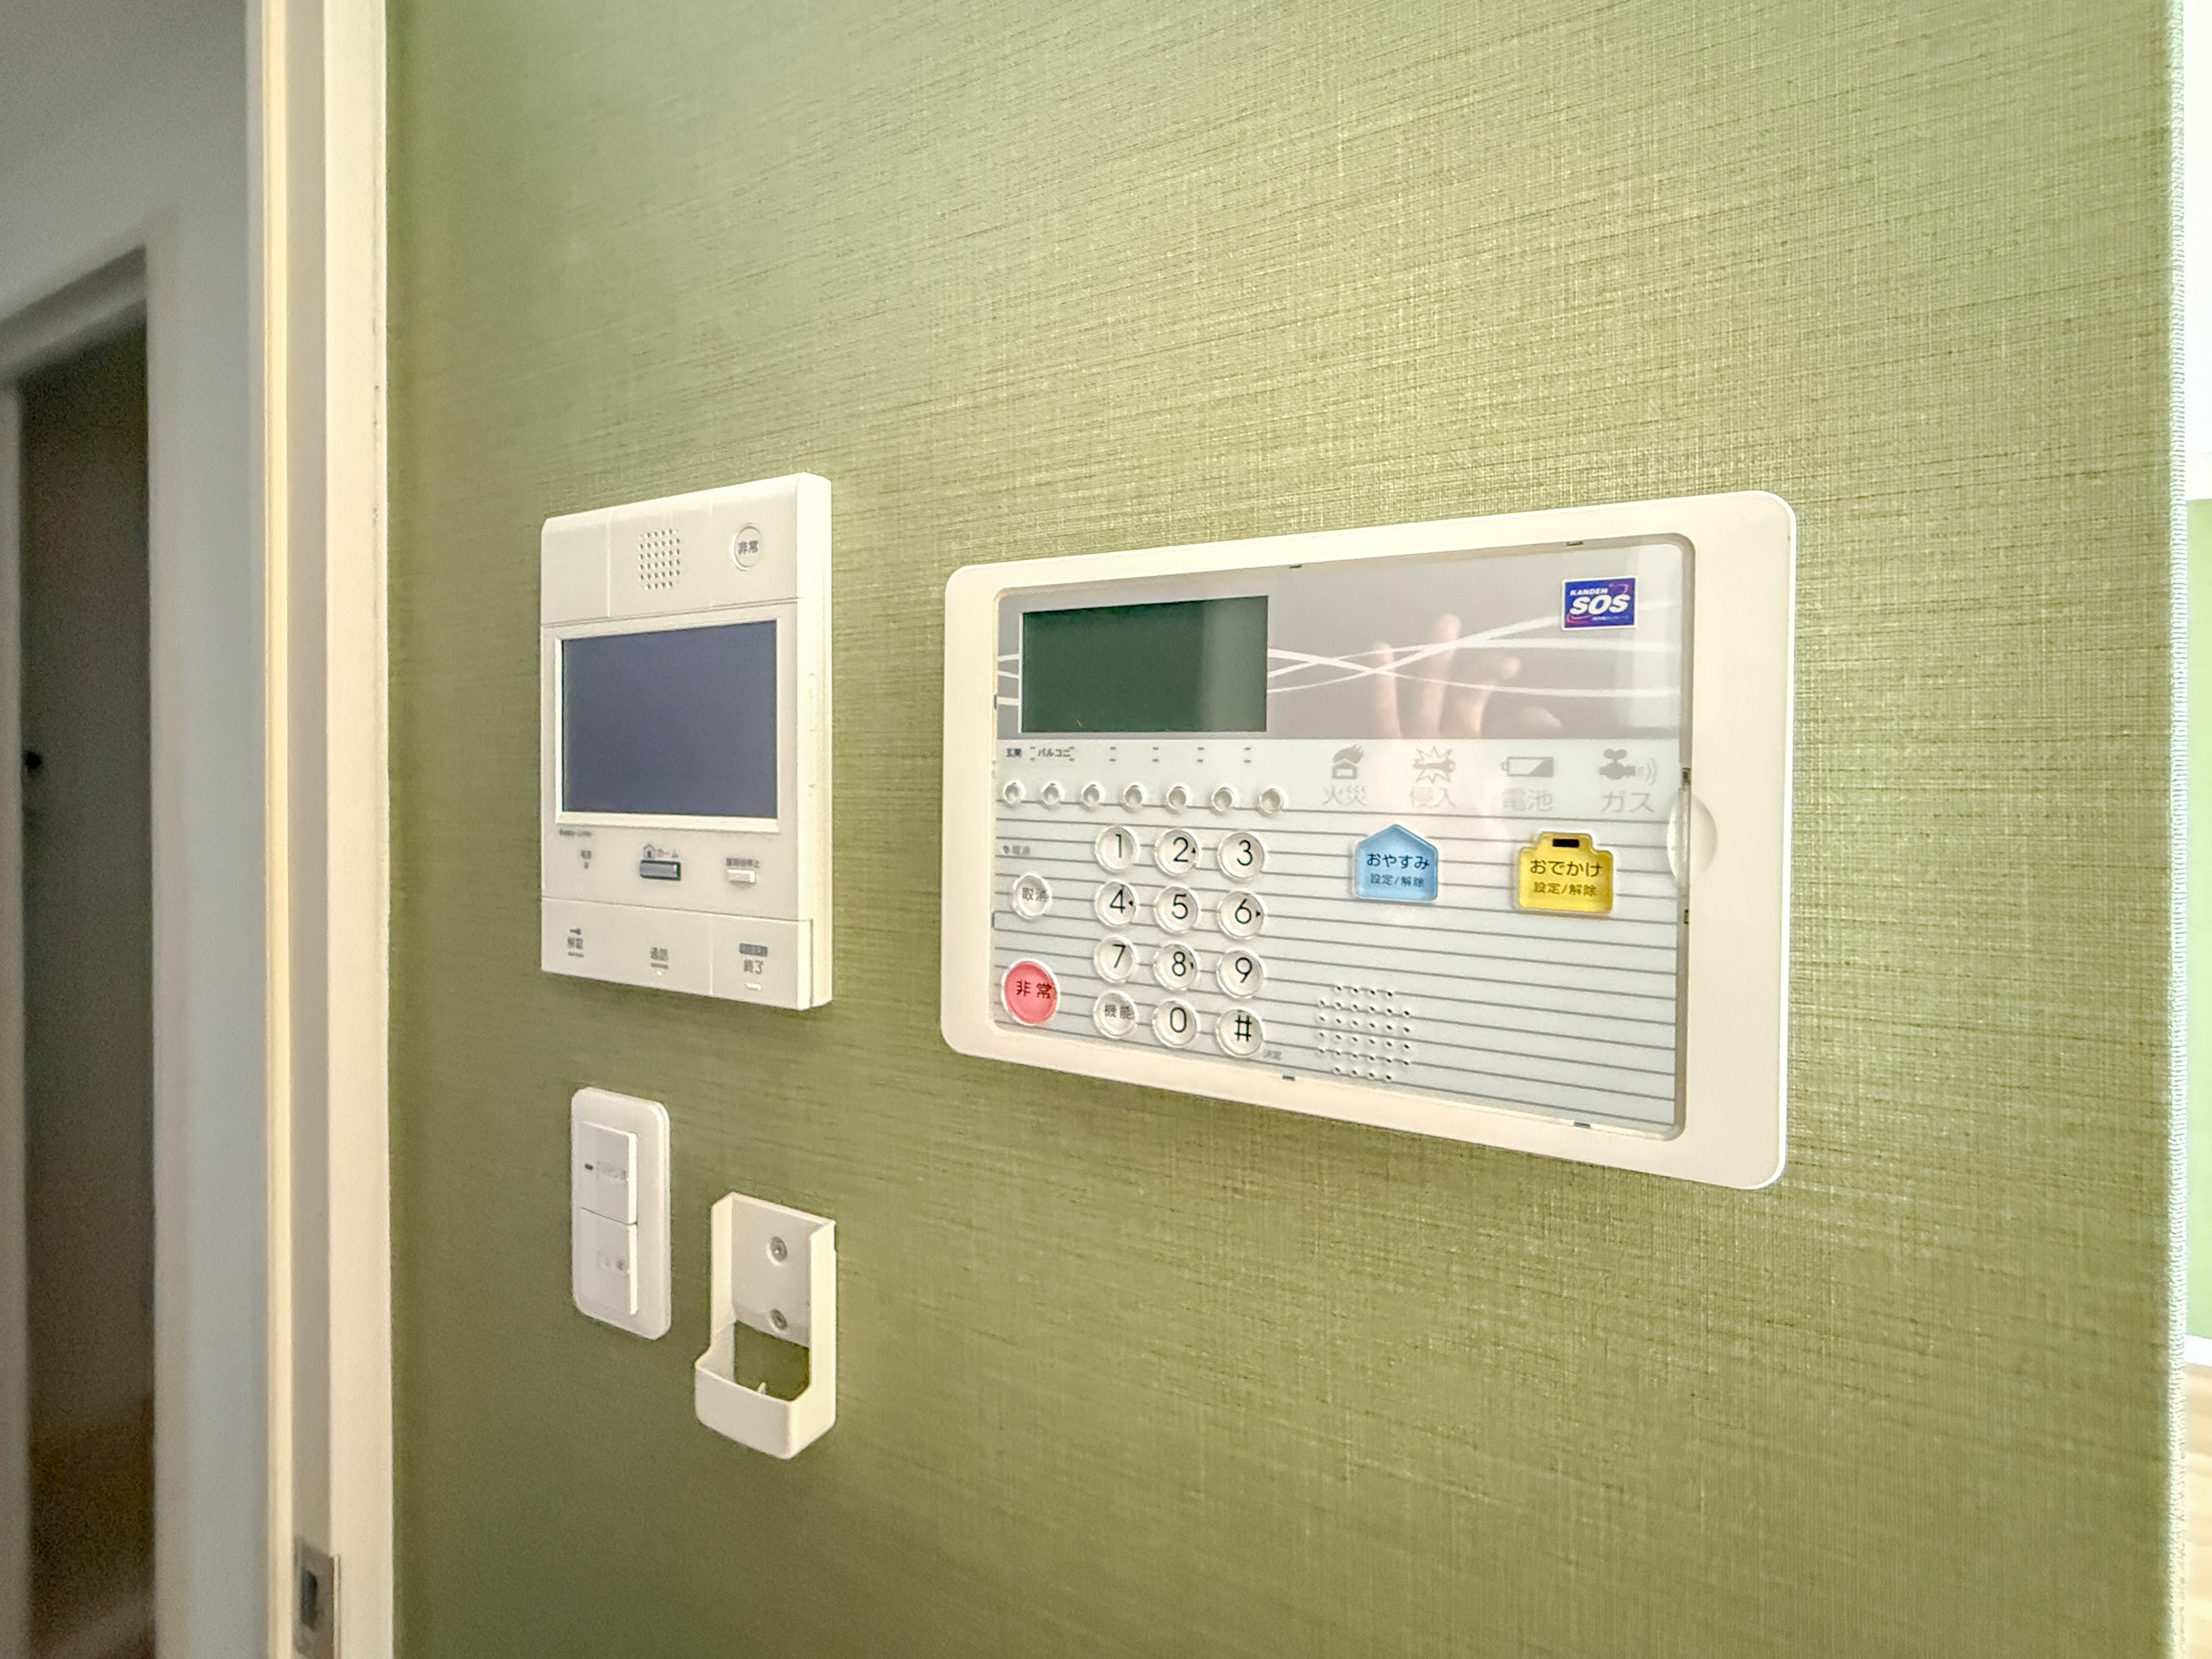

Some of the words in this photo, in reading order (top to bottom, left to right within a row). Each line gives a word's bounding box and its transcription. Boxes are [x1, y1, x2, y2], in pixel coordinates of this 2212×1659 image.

[738, 540, 758, 555] 非常
[1570, 588, 1609, 596] KANDEN
[1570, 594, 1631, 615] SOS
[1322, 785, 1367, 806] 火災
[1503, 787, 1553, 812] 電池
[1600, 790, 1654, 813] ガス
[1115, 833, 1122, 859] 1
[1173, 837, 1189, 862] 2
[1237, 839, 1253, 866] 3
[1367, 852, 1430, 870] おやすみ
[1530, 859, 1602, 877] おでかけ
[1370, 873, 1425, 888] 設定/解除
[1533, 881, 1597, 897] 設定/解除
[1109, 888, 1126, 914] 4
[1171, 893, 1189, 919] 5
[1234, 898, 1252, 924] 6
[1112, 944, 1127, 969] 7
[1172, 951, 1186, 977] 8
[1235, 957, 1253, 984] 9
[1016, 980, 1052, 999] 非常
[1170, 1007, 1187, 1033] 0
